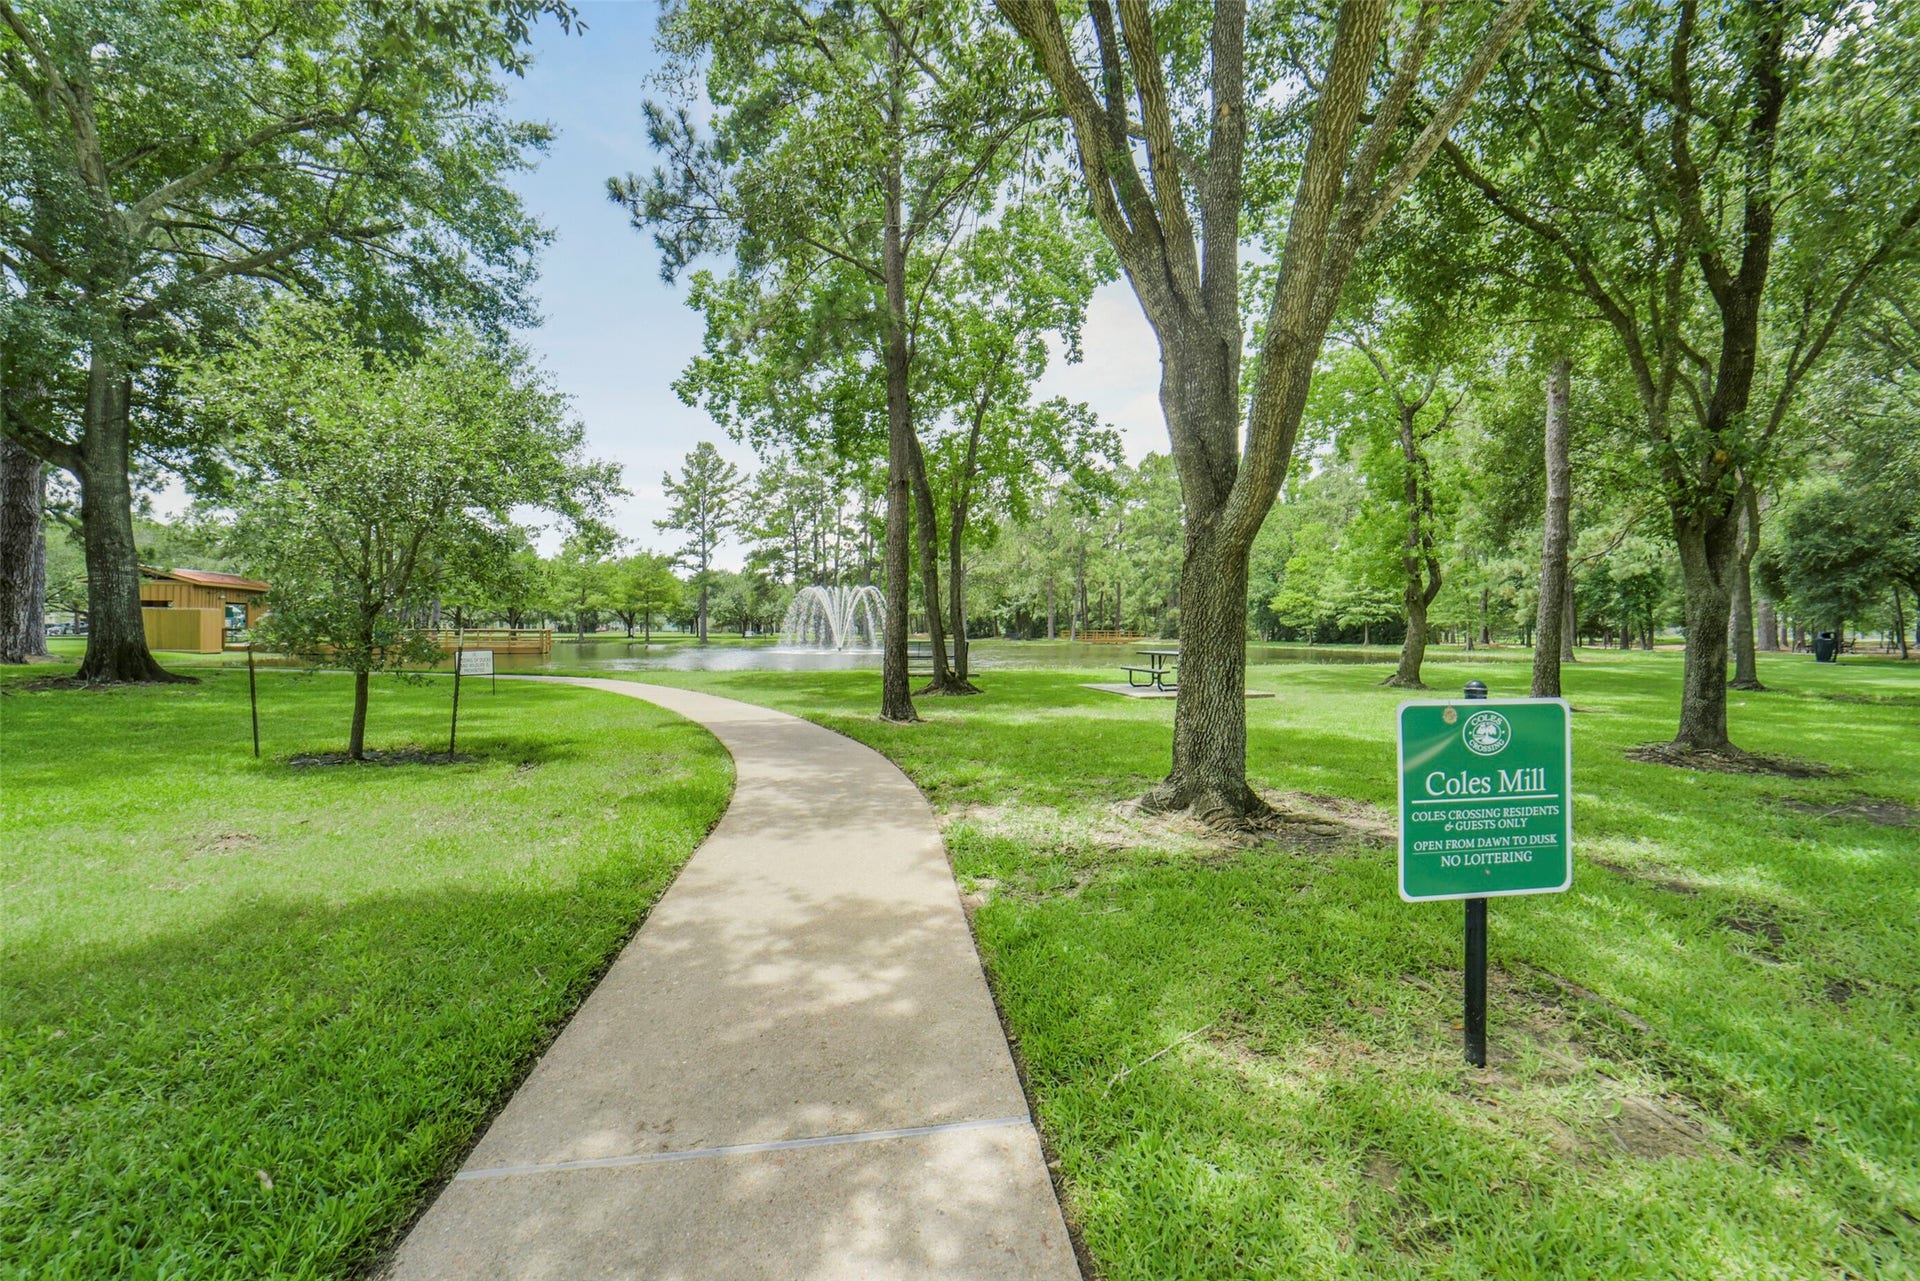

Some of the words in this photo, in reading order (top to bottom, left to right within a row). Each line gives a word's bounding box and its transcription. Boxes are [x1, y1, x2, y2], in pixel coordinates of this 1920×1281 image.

[1471, 714, 1502, 726] COLES
[1469, 739, 1504, 753] CROSSING
[1425, 771, 1491, 796] Coles
[1499, 768, 1546, 792] Mill
[1412, 811, 1446, 822] COLES
[1449, 808, 1500, 820] CROSSING
[1503, 805, 1559, 817] RESIDENTS
[1445, 821, 1454, 831] &
[1456, 819, 1495, 830] GUESTS
[1498, 818, 1528, 829] ONLY
[1414, 841, 1442, 851] OPEN
[1446, 839, 1475, 849] FROM
[1478, 837, 1510, 847] DAWN
[1513, 836, 1527, 845] TO
[1530, 834, 1557, 844] DUSK
[1441, 855, 1461, 867] NO
[1464, 851, 1532, 865] LOITERING
